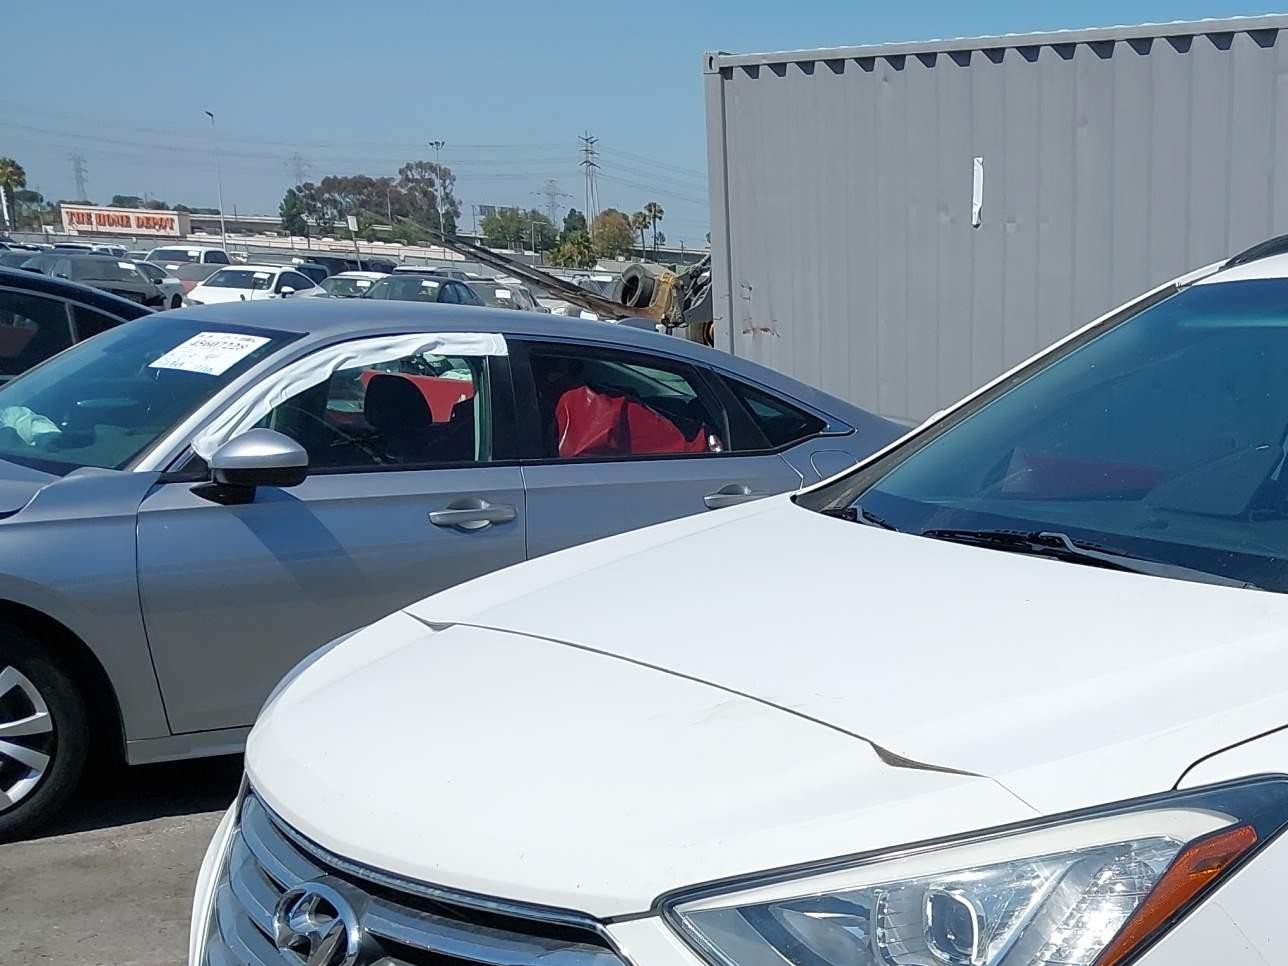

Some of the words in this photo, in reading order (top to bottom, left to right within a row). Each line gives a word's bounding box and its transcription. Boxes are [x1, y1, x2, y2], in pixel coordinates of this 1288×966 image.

[65, 210, 93, 225] THE
[95, 213, 132, 228] HOME
[136, 215, 176, 231] DEPOT
